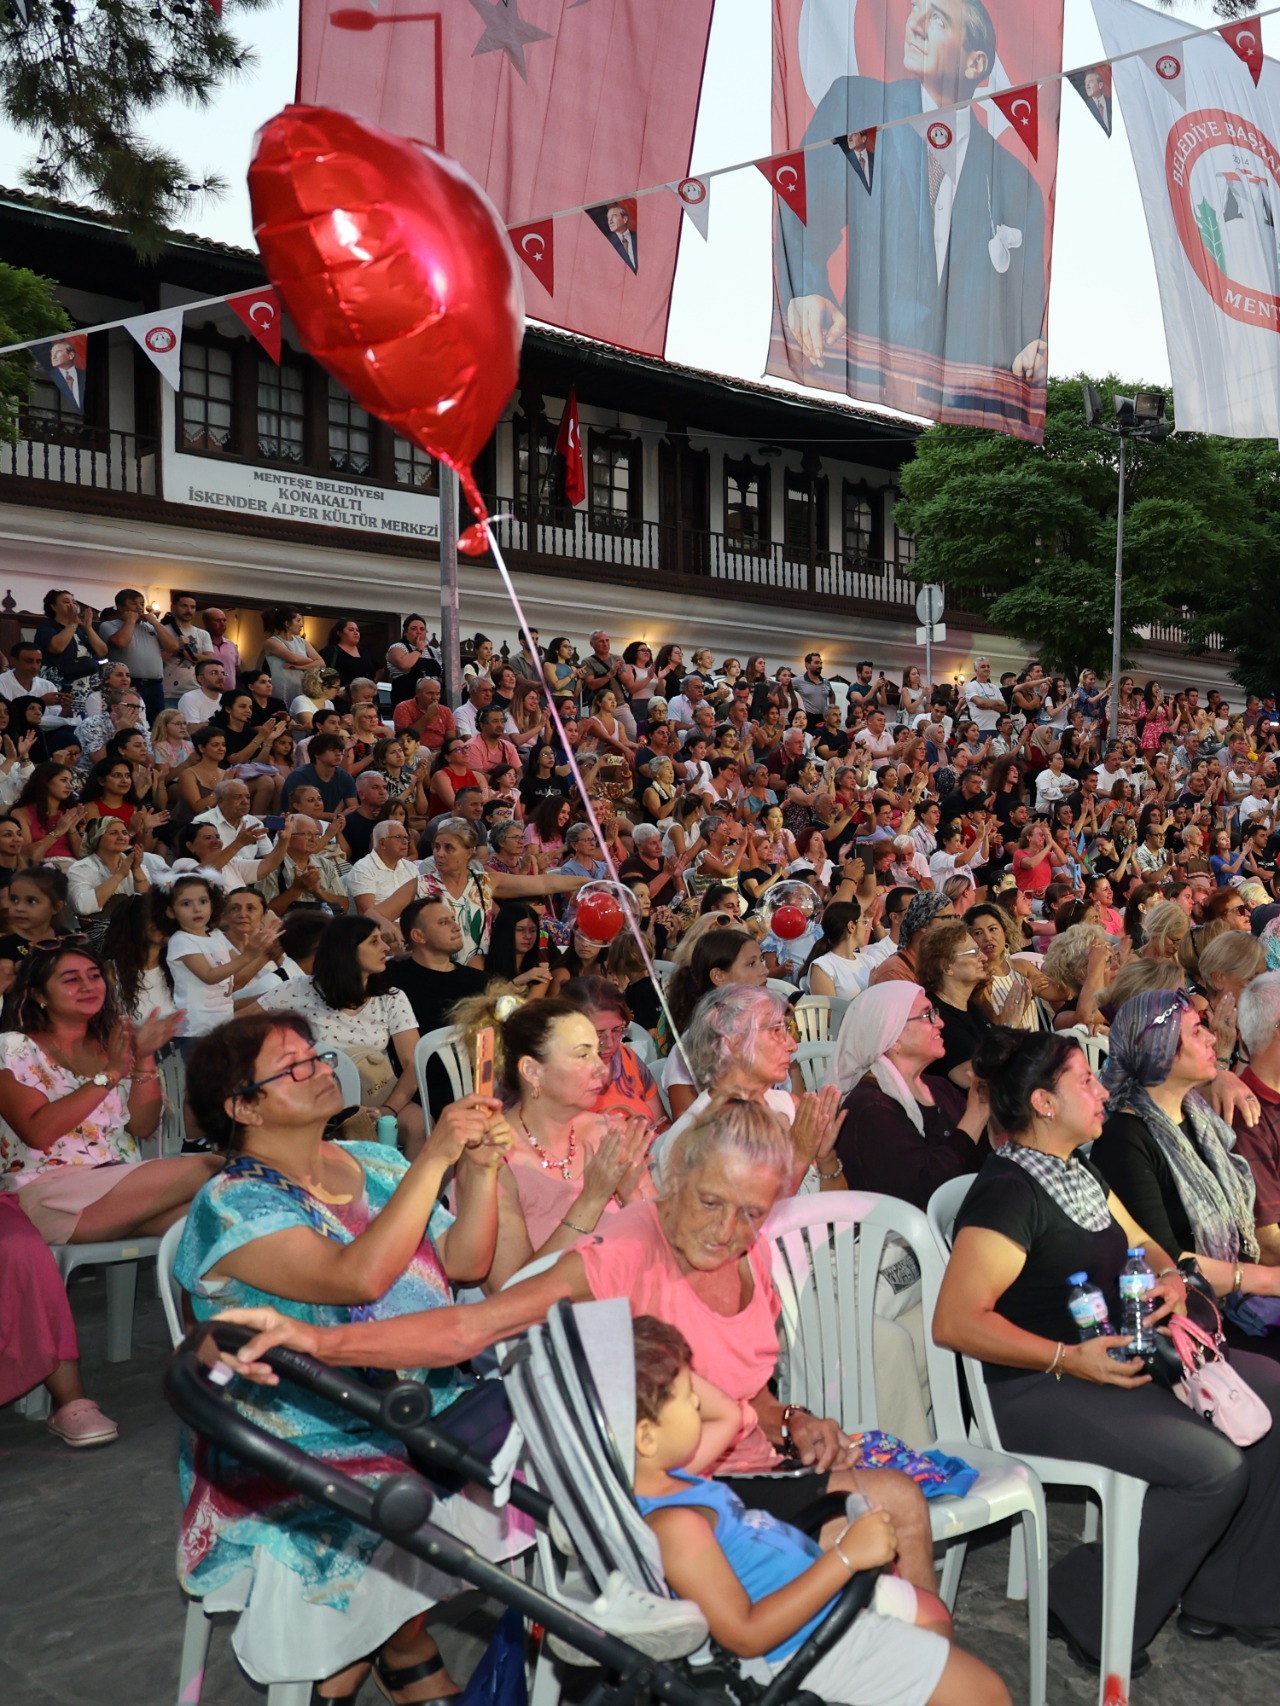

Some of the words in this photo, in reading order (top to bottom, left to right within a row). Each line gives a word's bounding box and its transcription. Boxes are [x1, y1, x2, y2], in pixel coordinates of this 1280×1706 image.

[1173, 121, 1222, 188] BELEDİYE
[253, 471, 313, 489] MENTEŞE
[188, 486, 268, 512] İSKENDER
[271, 502, 319, 520] ALPER
[322, 509, 378, 528] KÜLTÜR
[380, 519, 439, 538] MERKEZİ
[278, 488, 362, 511] KONAKALTI
